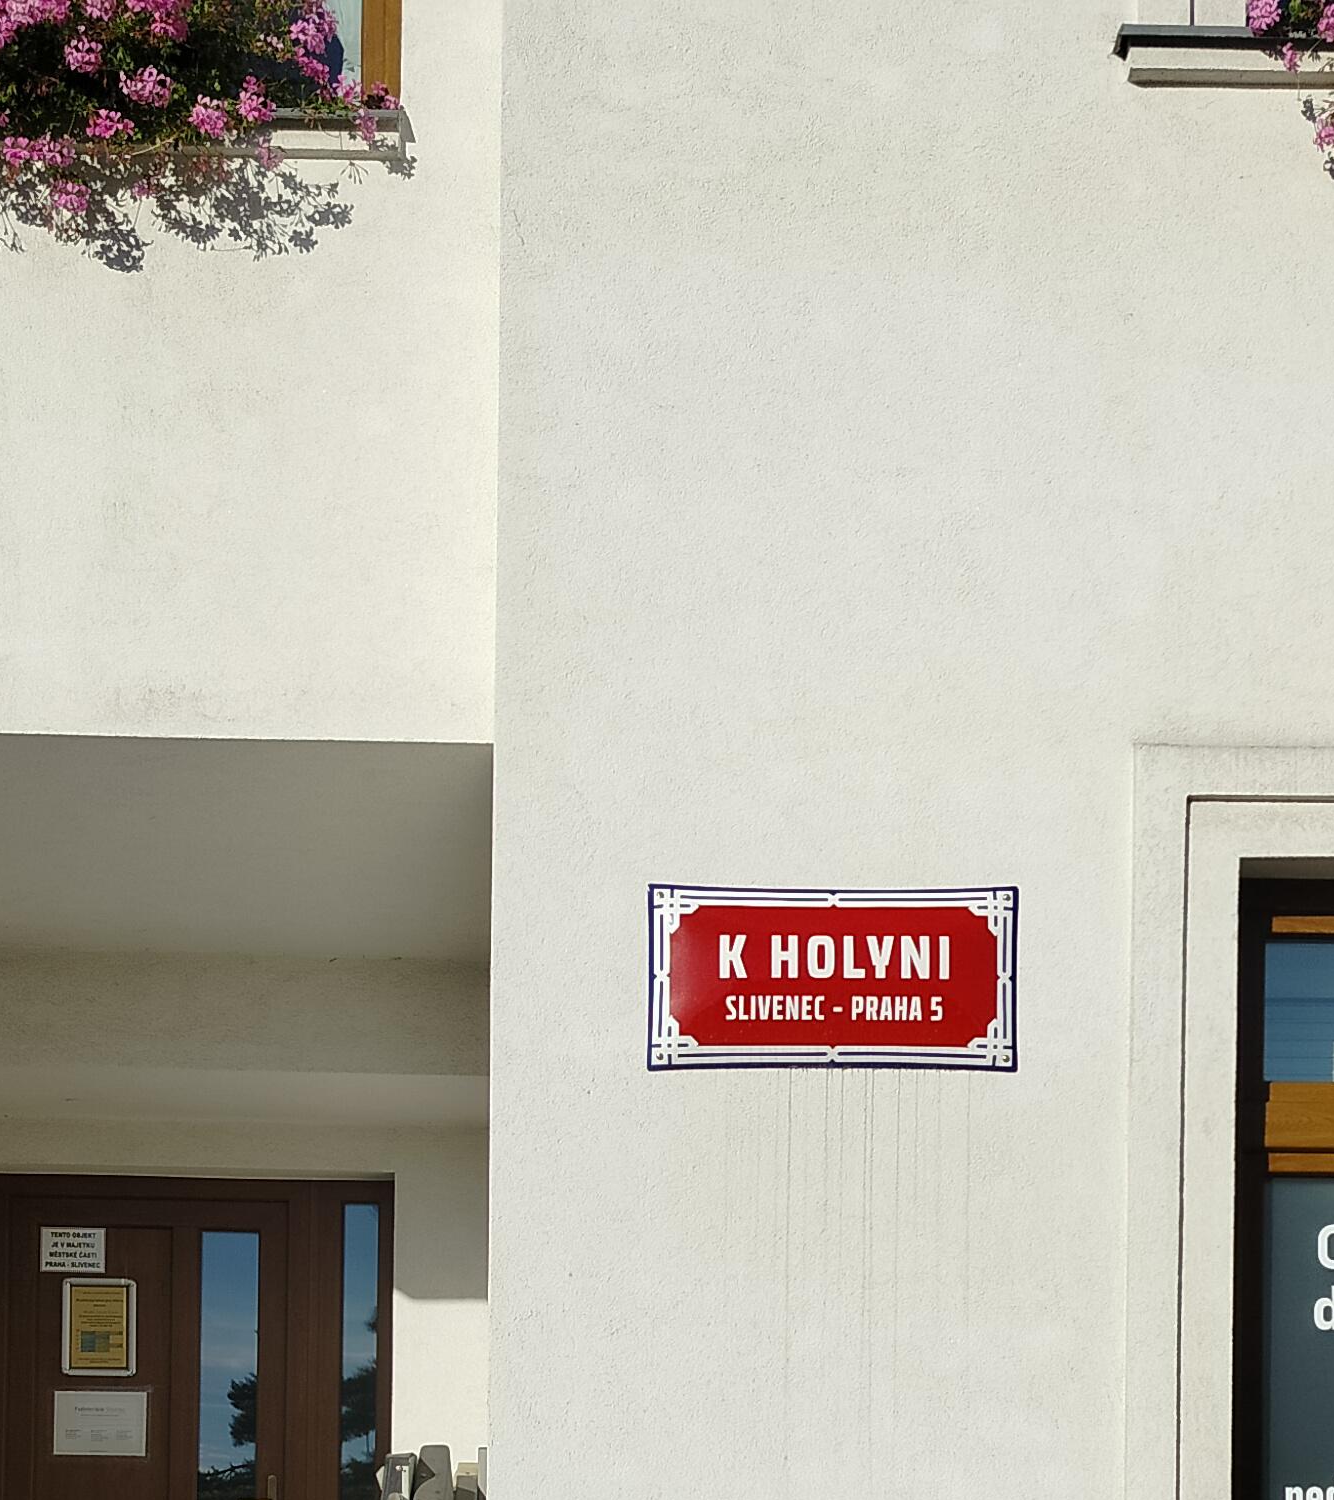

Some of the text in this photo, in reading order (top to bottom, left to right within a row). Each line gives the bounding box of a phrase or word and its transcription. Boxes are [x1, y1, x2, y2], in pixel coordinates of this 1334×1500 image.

[718, 934, 951, 981] K HOLYNI
[724, 995, 825, 1021] SLIVENEC
[851, 996, 923, 1022] PRAHA
[930, 996, 944, 1022] 5
